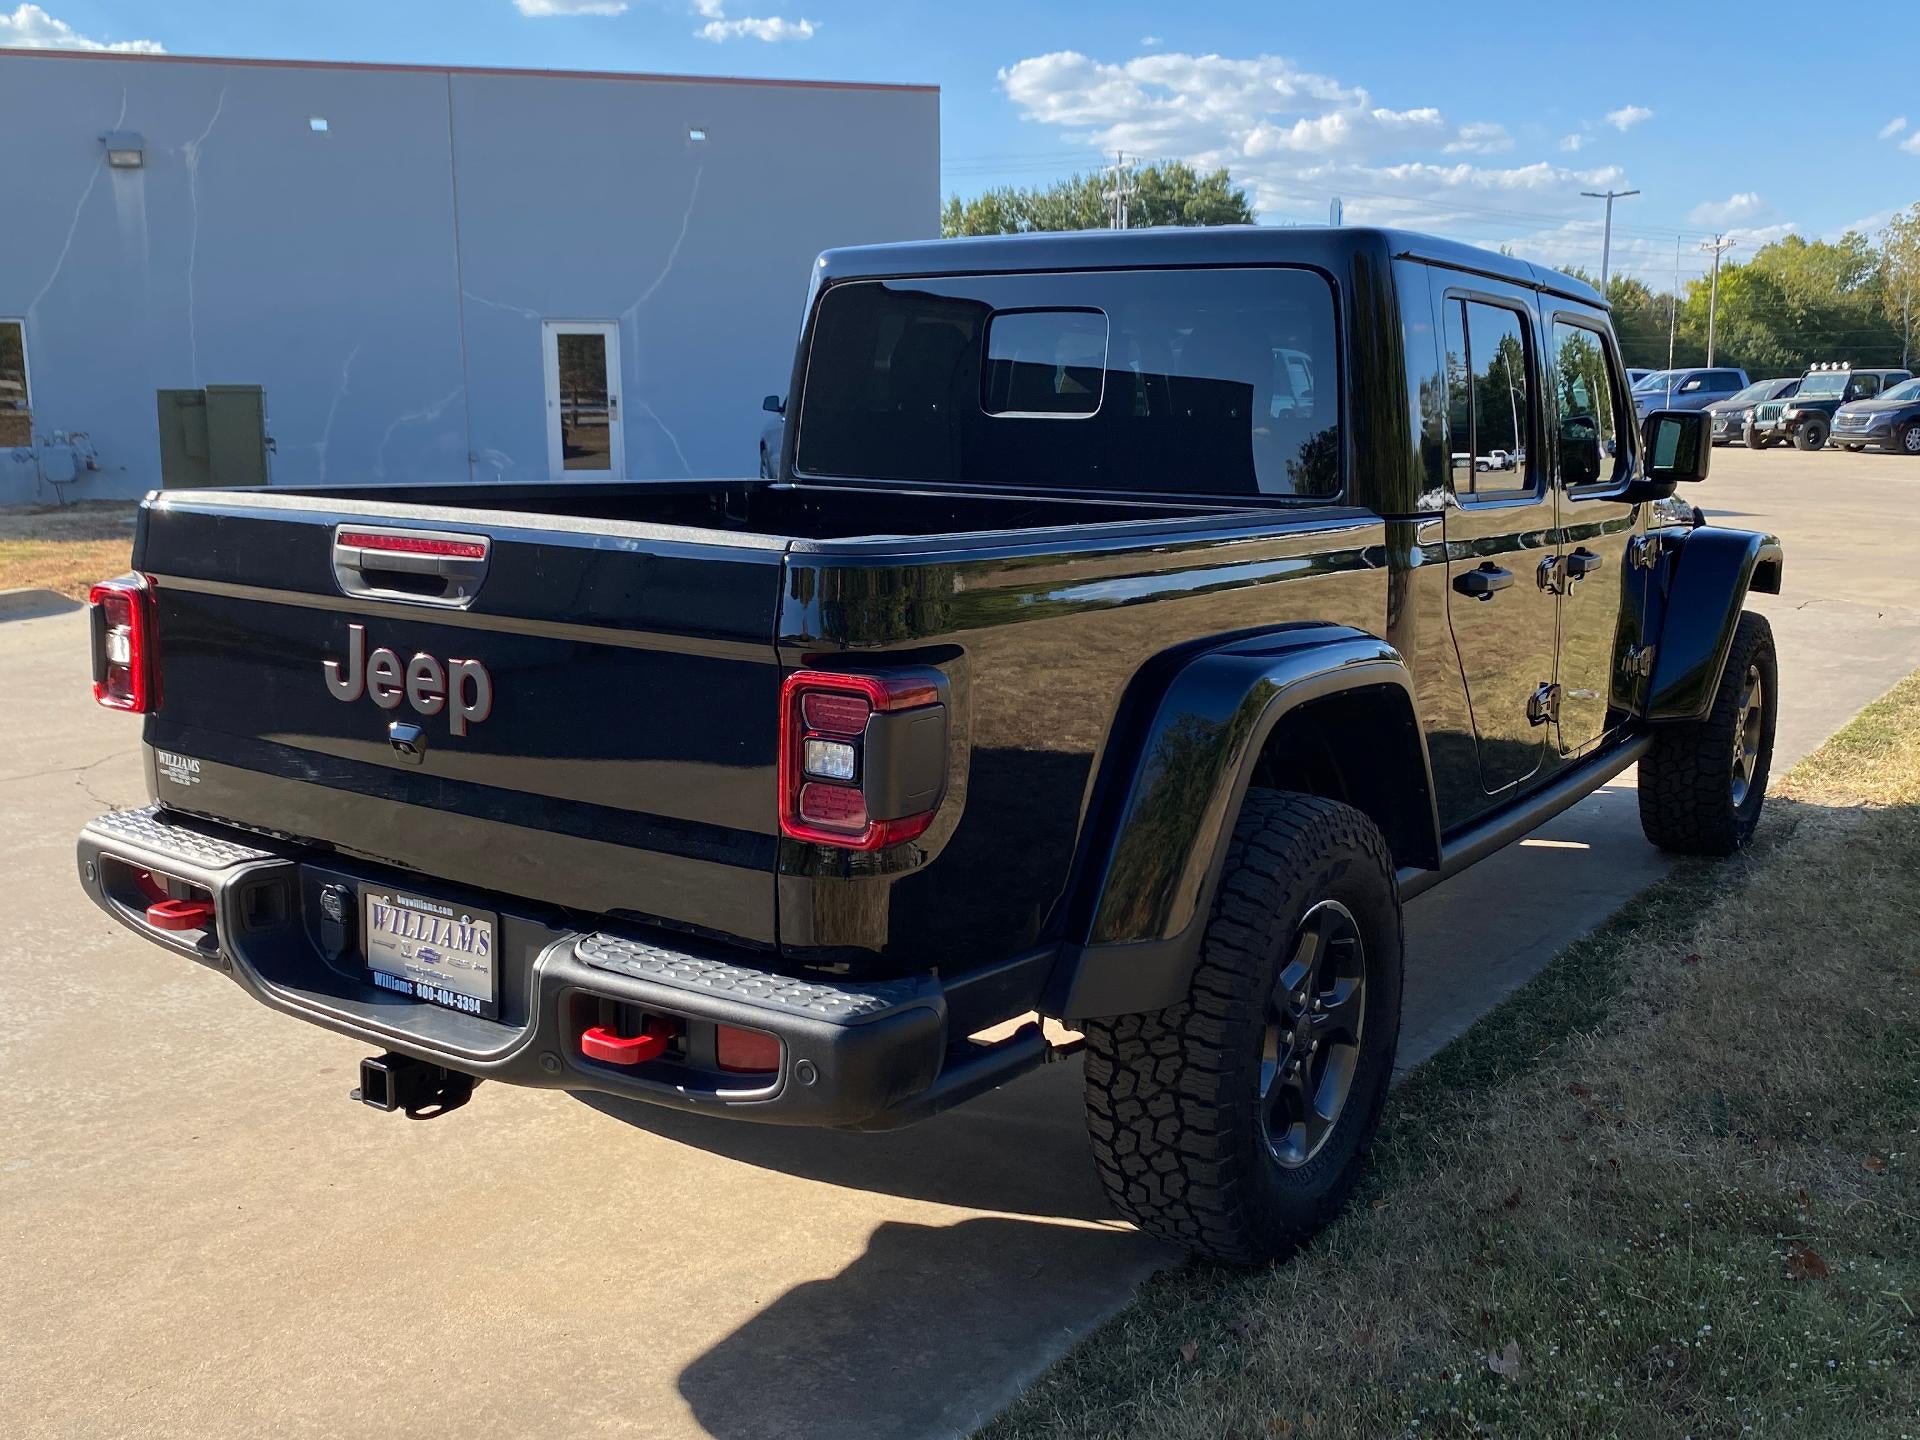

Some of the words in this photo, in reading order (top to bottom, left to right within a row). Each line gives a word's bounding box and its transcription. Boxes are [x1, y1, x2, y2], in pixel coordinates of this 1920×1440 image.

[322, 624, 493, 737] Jeep
[158, 751, 200, 773] WILLIAMS
[372, 903, 490, 956] WILLIAMS
[374, 971, 413, 995] Williams
[416, 983, 481, 1014] 800-404-3394
